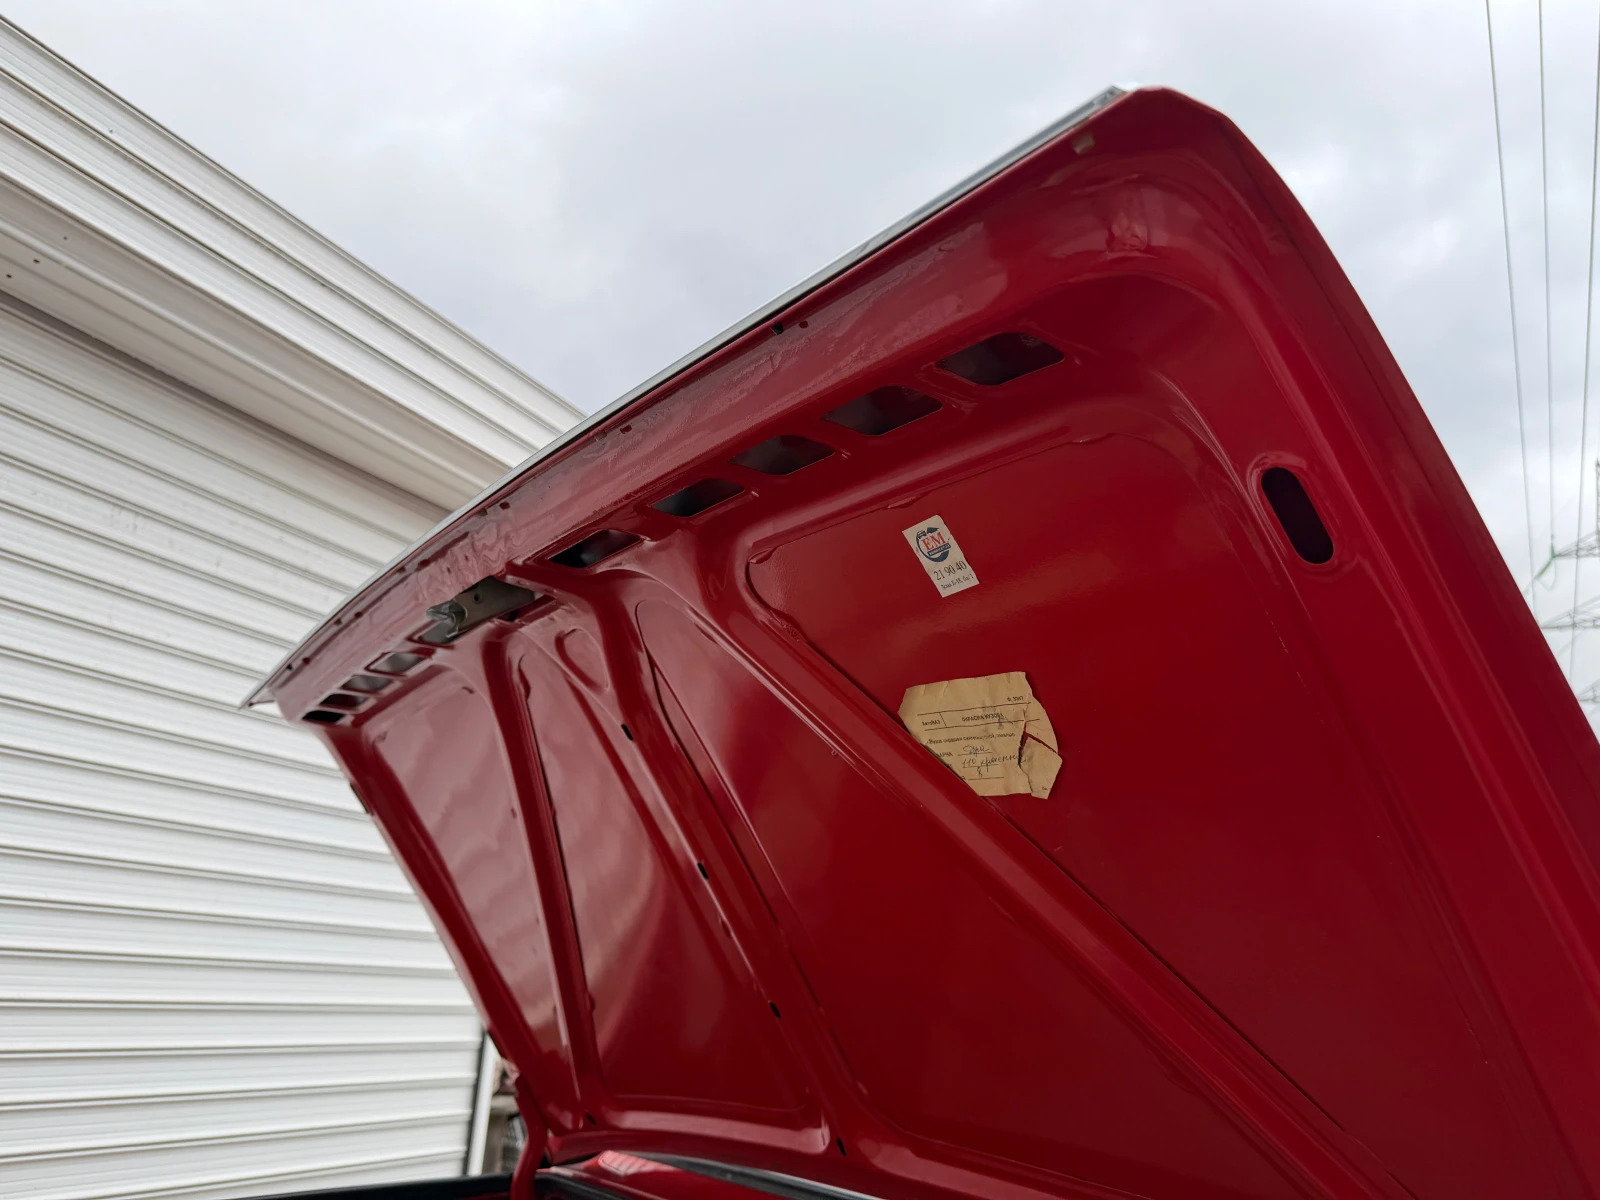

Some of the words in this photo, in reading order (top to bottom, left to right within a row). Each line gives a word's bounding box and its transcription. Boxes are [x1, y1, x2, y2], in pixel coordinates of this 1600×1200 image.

[933, 570, 945, 580] 21
[944, 565, 955, 576] 90
[955, 560, 967, 571] 40
